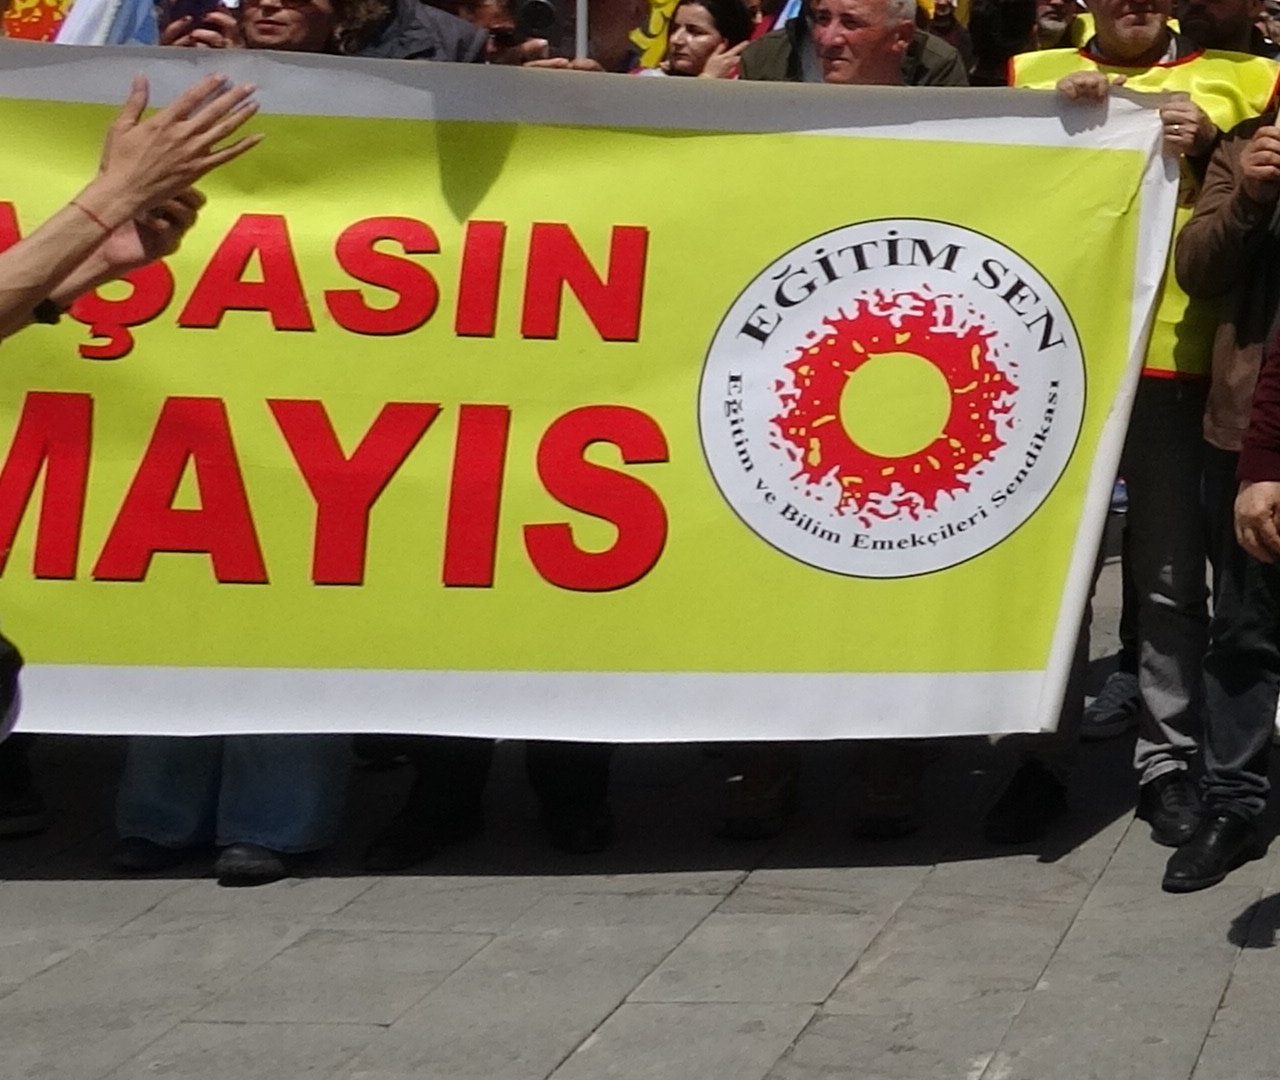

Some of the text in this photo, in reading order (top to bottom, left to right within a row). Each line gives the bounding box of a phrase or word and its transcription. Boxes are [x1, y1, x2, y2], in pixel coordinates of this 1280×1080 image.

[0, 202, 648, 360] ŞASIN
[737, 230, 1069, 353] EĞİTİM SEN
[723, 372, 1061, 551] Eğitim ve Bilim Emekçileri Sendikası
